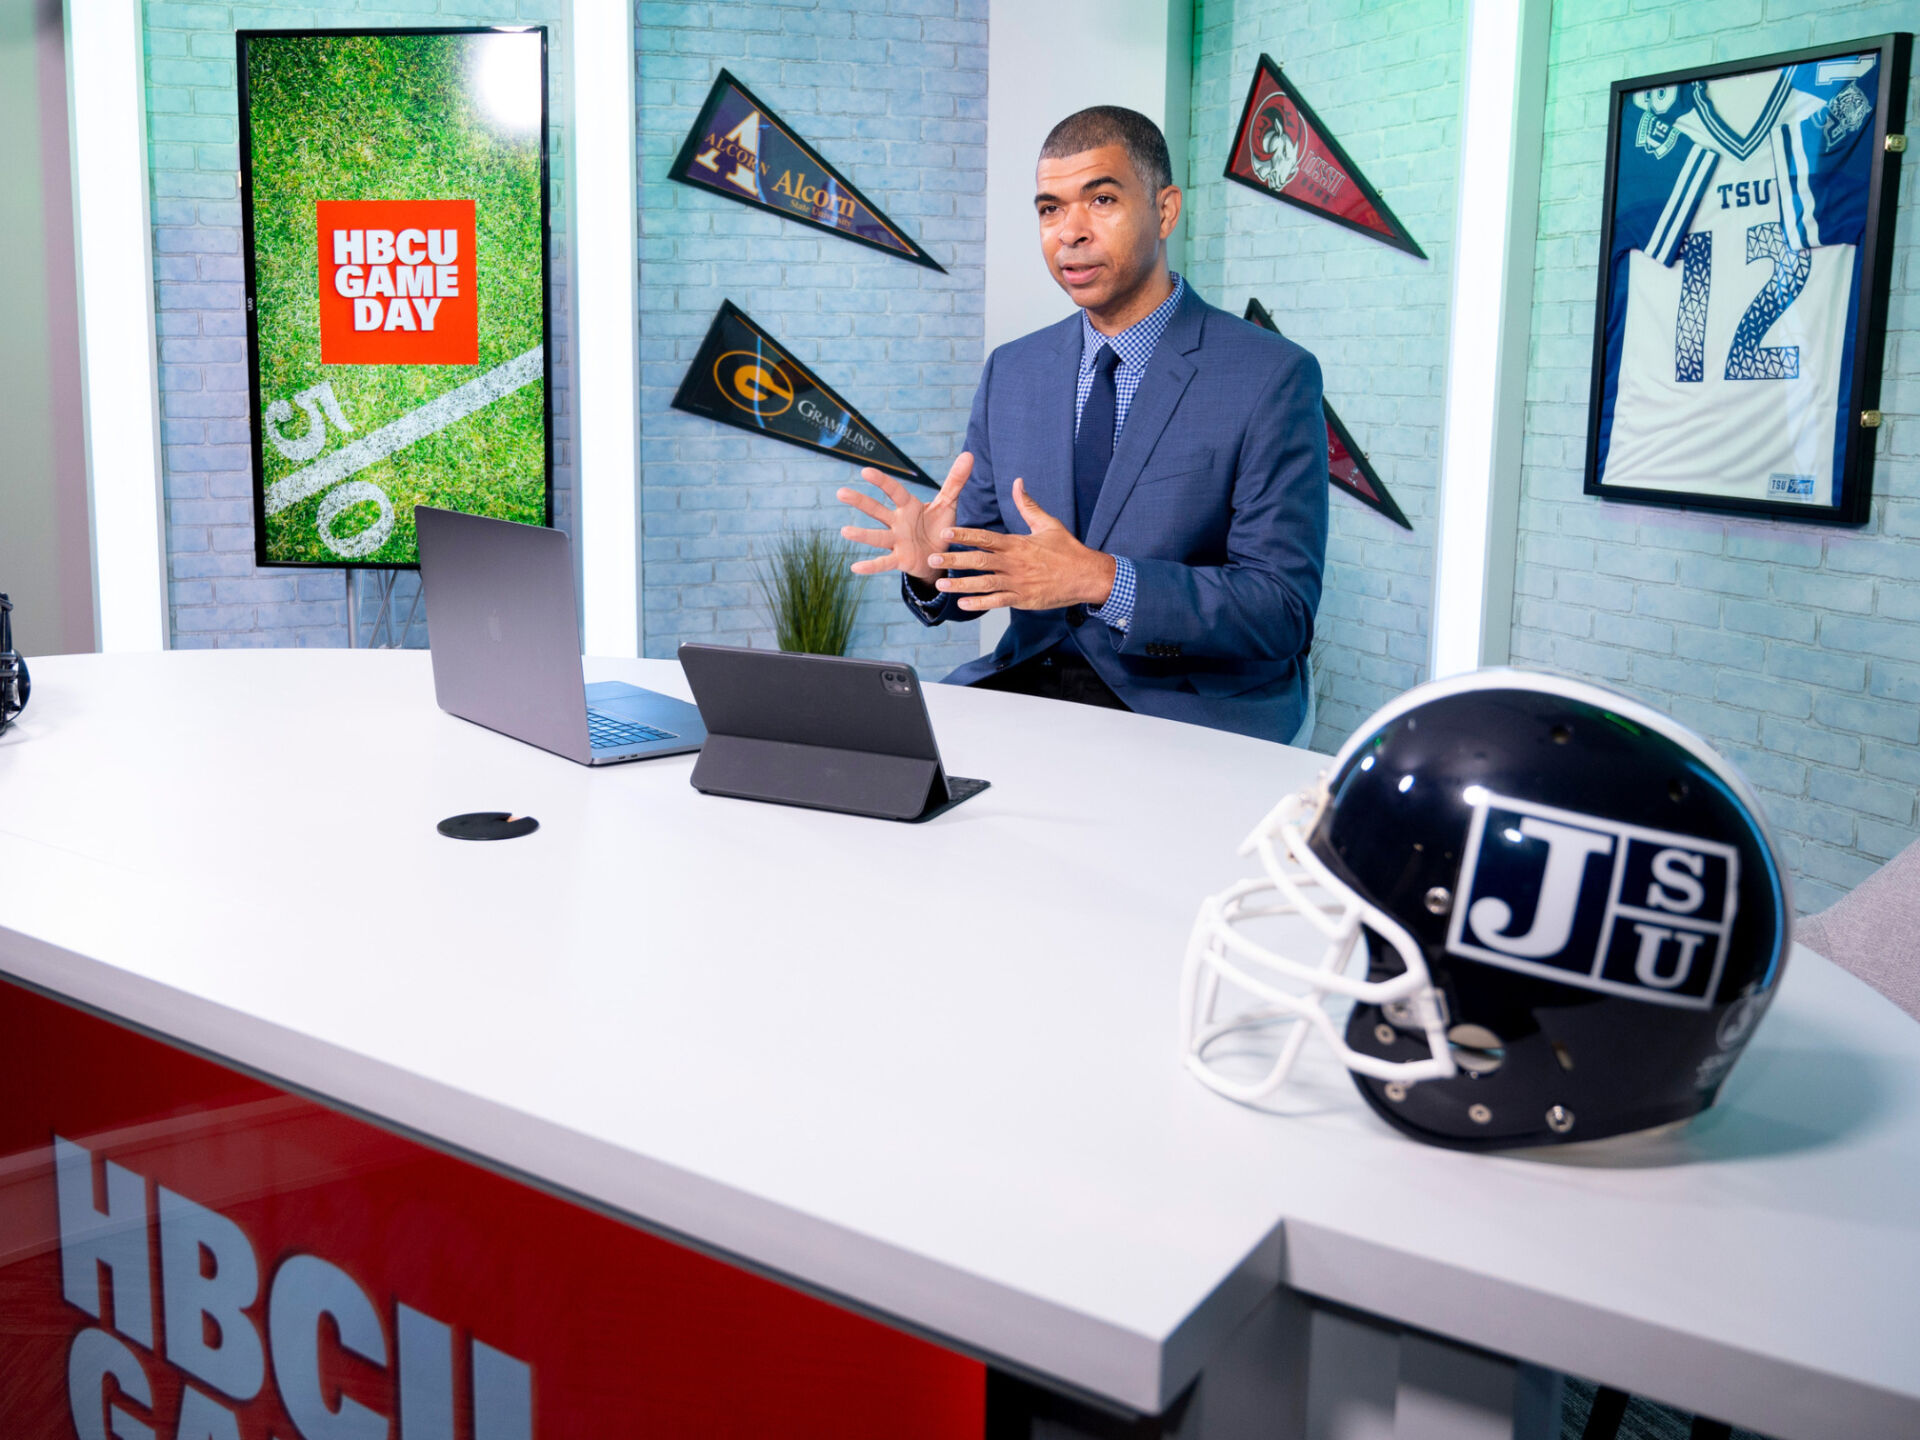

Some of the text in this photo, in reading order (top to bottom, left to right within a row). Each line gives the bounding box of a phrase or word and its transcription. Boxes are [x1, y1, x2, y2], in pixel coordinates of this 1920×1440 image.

[1651, 120, 1669, 139] TS
[695, 110, 760, 196] A
[704, 131, 772, 177] ALCORN
[771, 169, 856, 219] Alcorn
[1717, 178, 1772, 209] TSU
[333, 228, 458, 265] HBCU
[334, 264, 459, 298] GAME
[353, 298, 443, 331] DAY
[1675, 222, 1812, 382] 12
[797, 400, 876, 452] GRAMBLING
